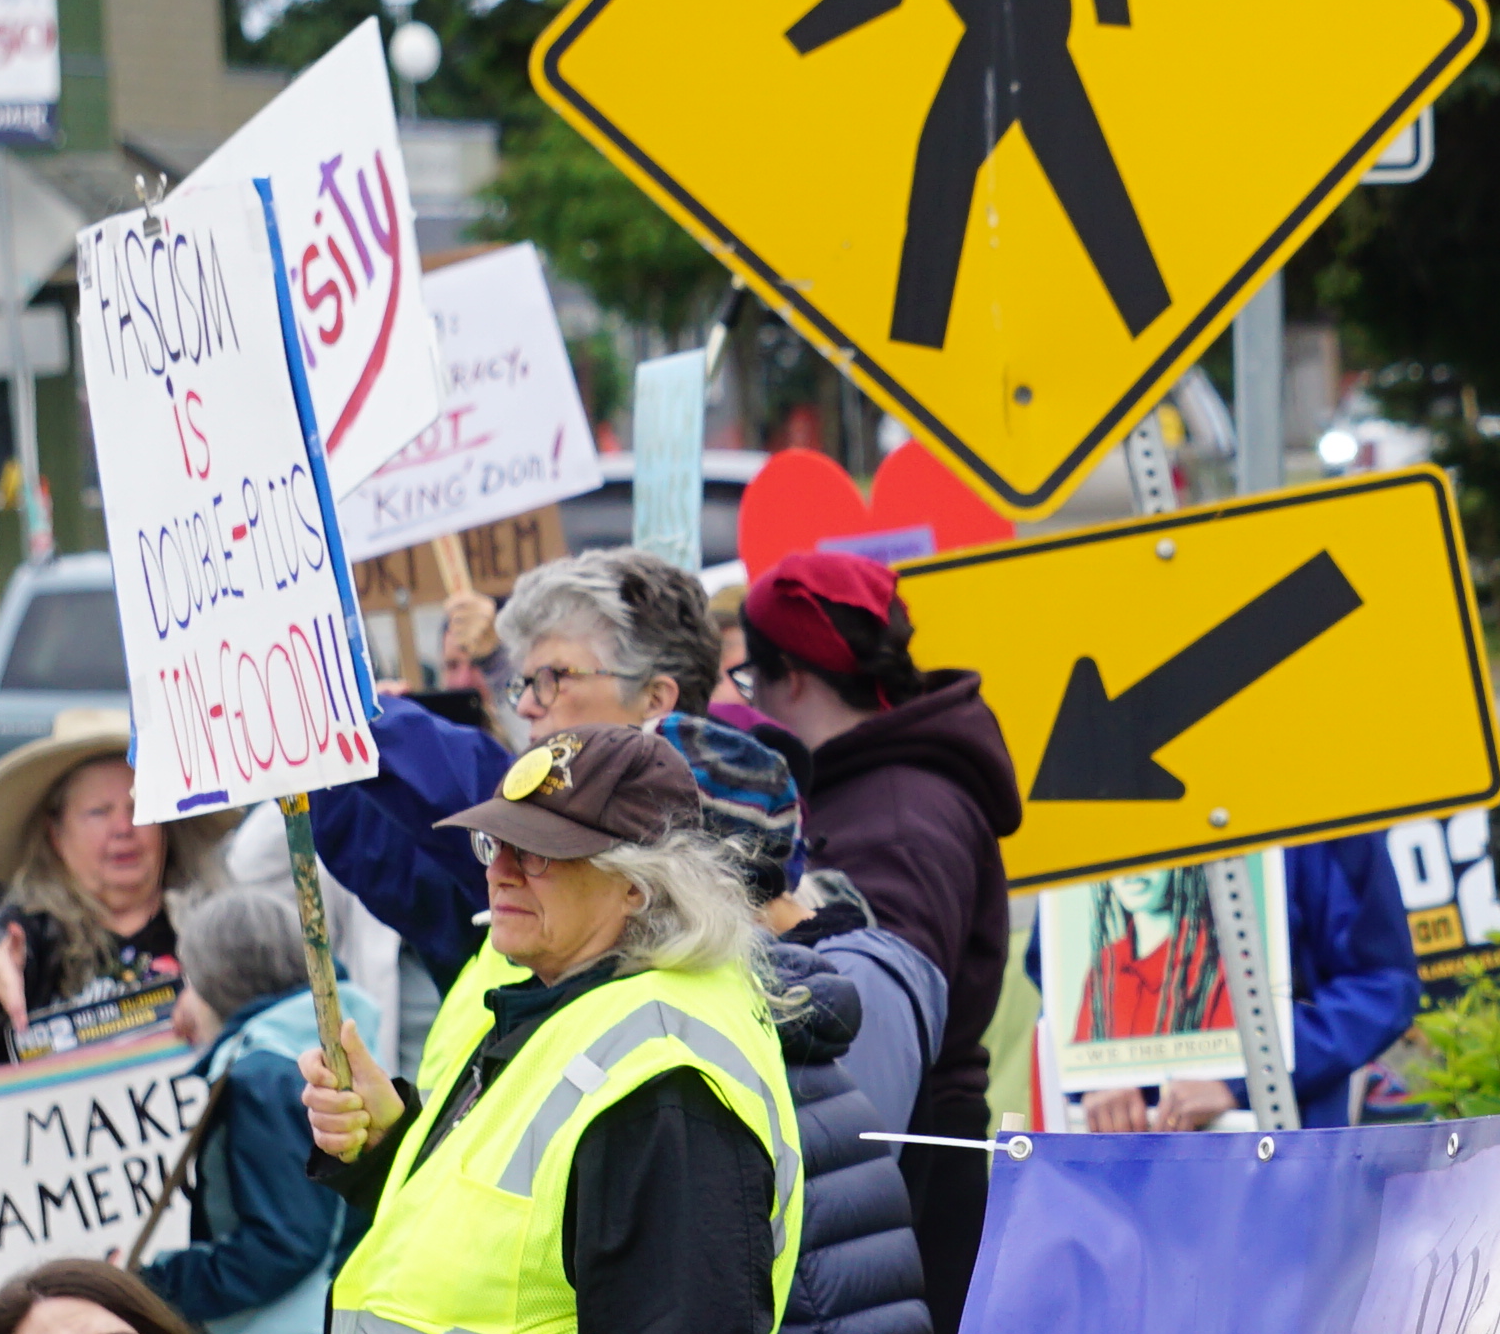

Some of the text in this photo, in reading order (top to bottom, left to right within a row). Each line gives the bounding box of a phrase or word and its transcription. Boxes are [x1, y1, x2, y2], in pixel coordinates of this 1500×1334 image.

[138, 463, 325, 640] DOUBLE-PLUS
[1173, 1036, 1232, 1054] PEOPL
[22, 1073, 210, 1166] MAKE
